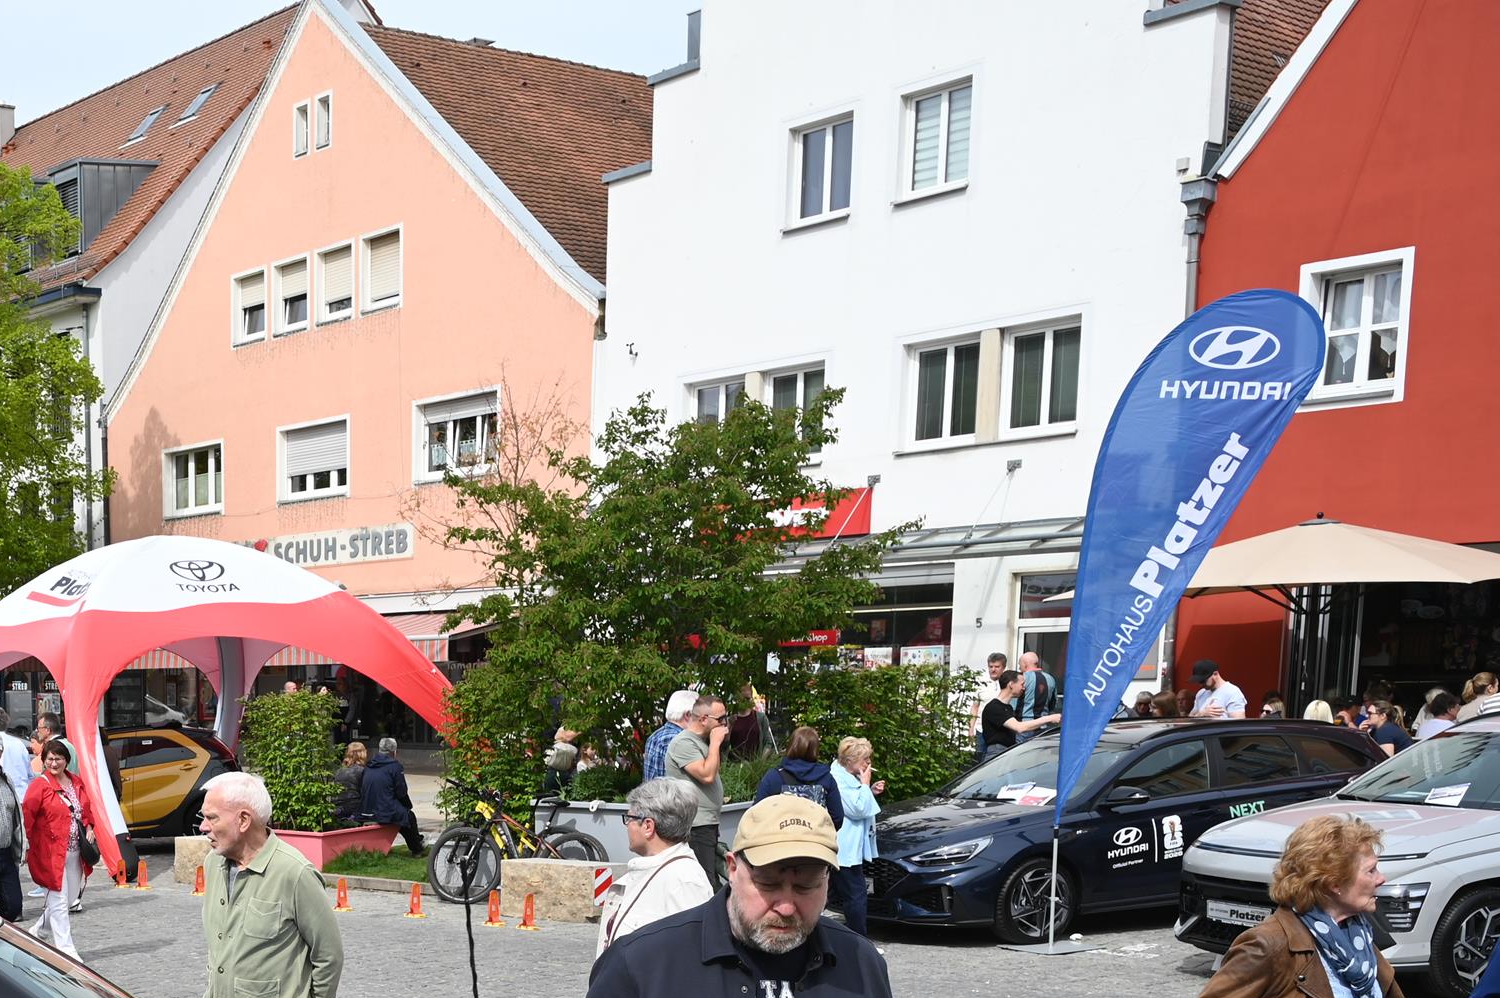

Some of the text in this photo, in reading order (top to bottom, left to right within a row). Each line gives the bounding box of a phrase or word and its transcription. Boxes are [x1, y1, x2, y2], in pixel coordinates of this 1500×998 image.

[1159, 380, 1292, 401] HYUNDAI
[1082, 432, 1250, 707] AUTOHAUS Platzer
[176, 583, 241, 592] TOYOTA
[975, 617, 983, 628] 5
[1229, 800, 1265, 818] NEXT
[779, 818, 813, 830] GLOBAL
[1107, 843, 1149, 859] HYUNDAI
[1230, 909, 1266, 922] Platzer
